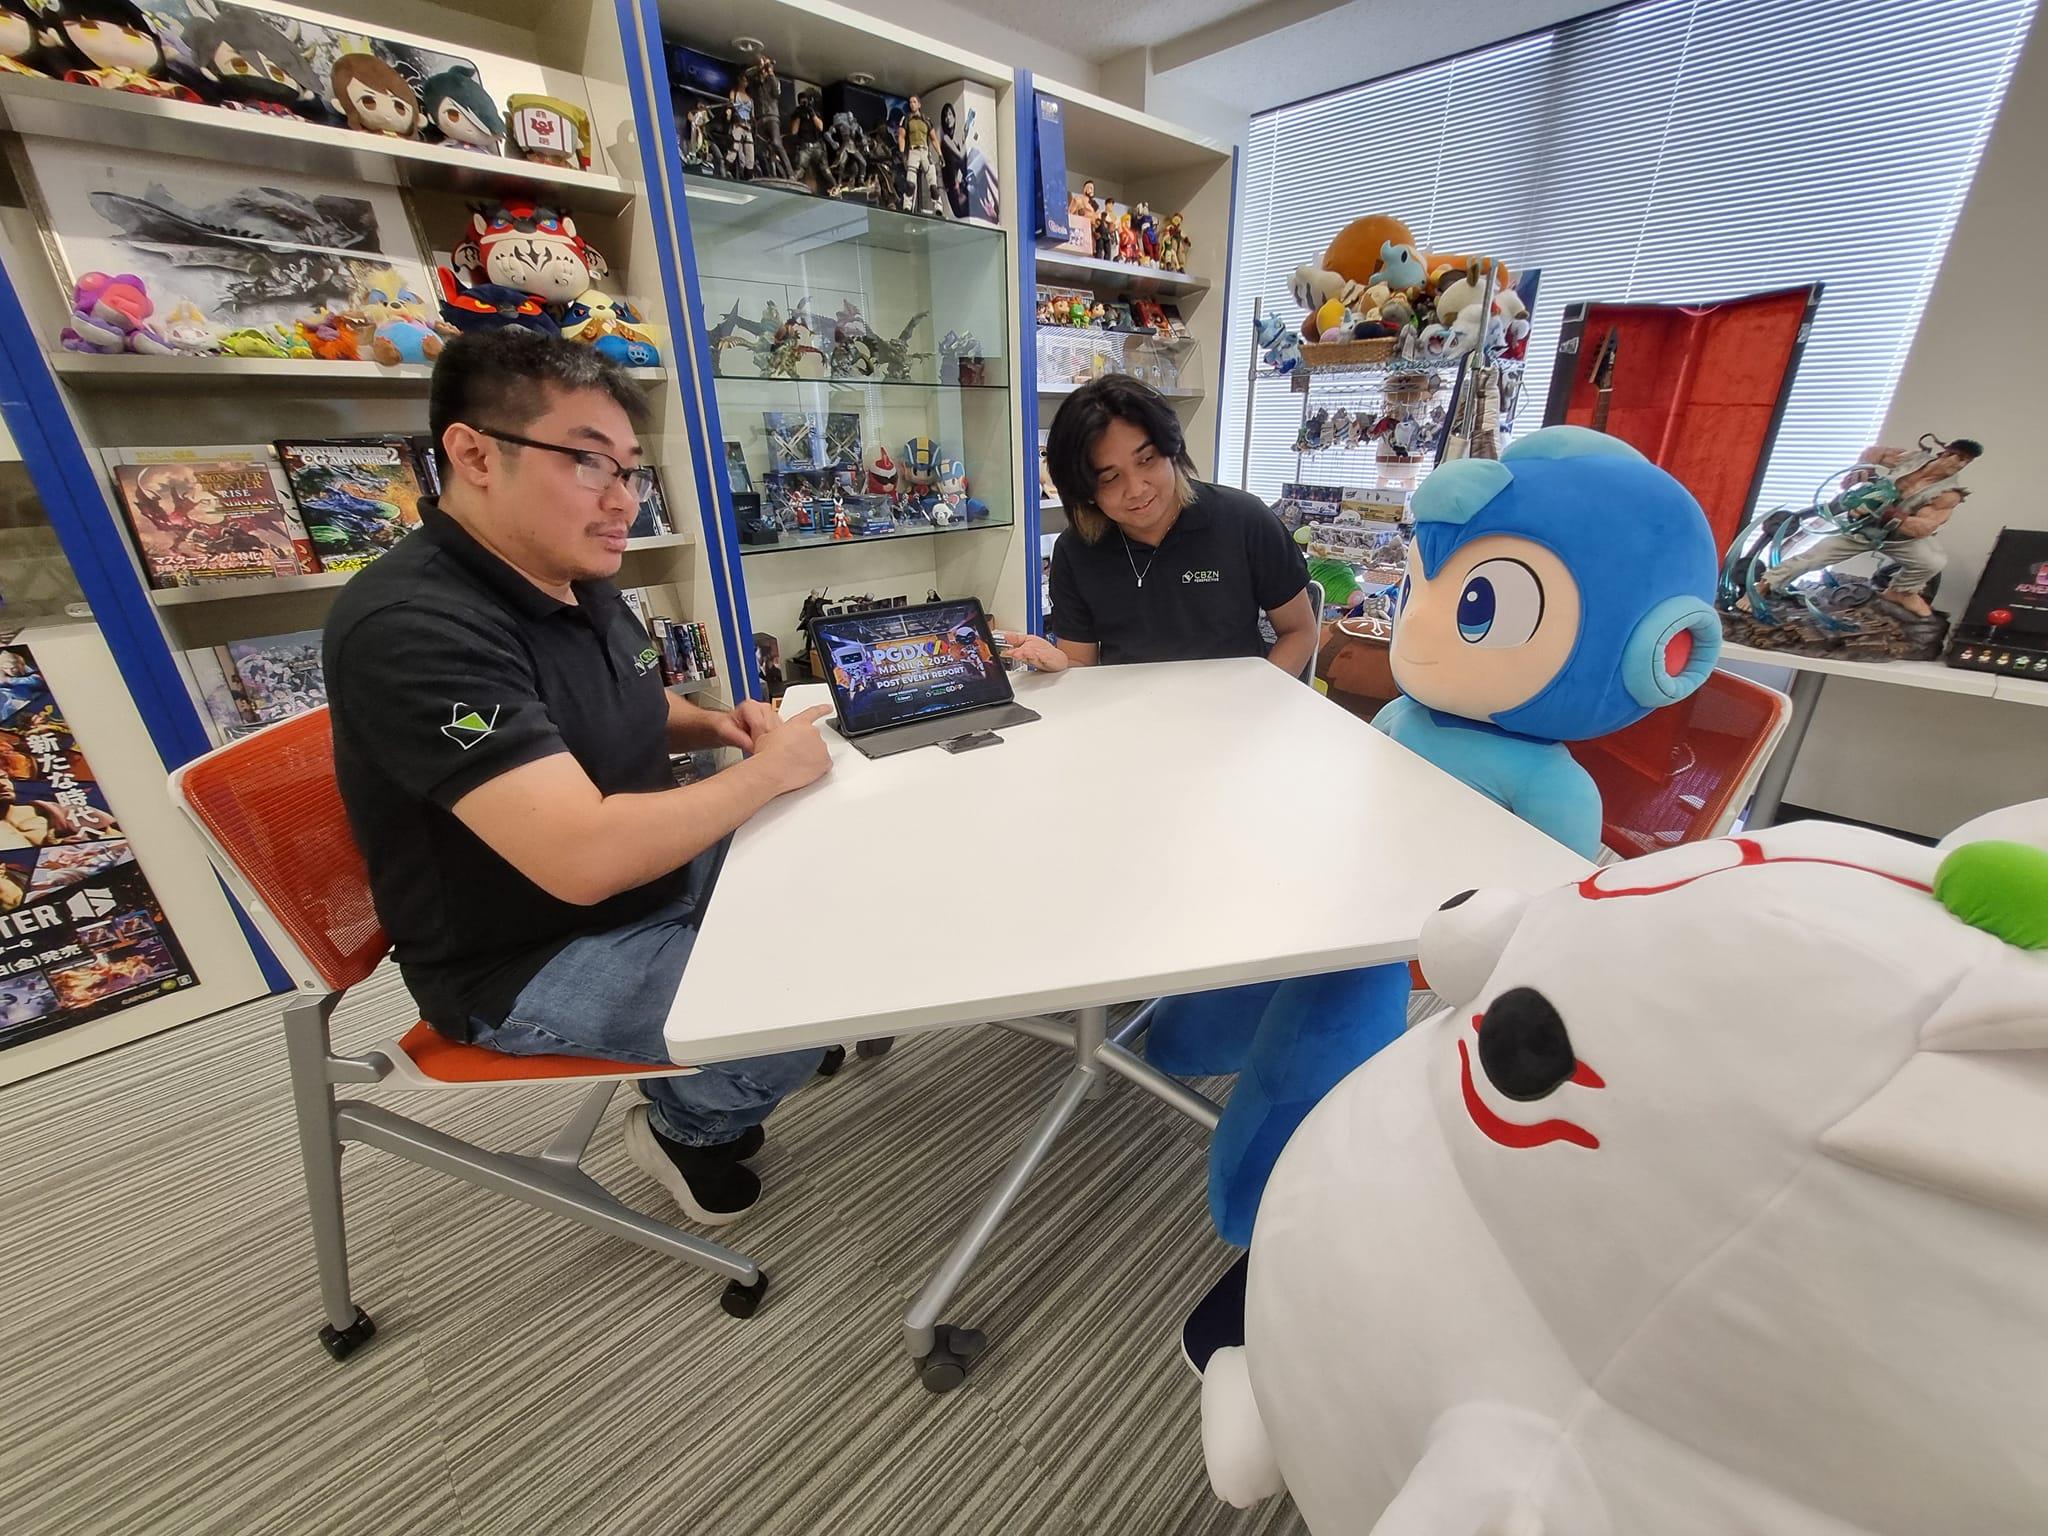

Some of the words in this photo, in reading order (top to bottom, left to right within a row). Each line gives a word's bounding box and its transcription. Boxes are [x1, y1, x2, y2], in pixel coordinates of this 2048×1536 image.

[220, 489, 251, 498] RISE
[1194, 570, 1220, 579] CBZN
[872, 642, 929, 665] PGDX
[878, 660, 925, 675] MANILA
[927, 655, 954, 666] 2024
[876, 678, 900, 689] POST
[902, 673, 930, 684] EVENT
[931, 666, 965, 679] REPORT
[25, 732, 106, 838] 新たな時代へ
